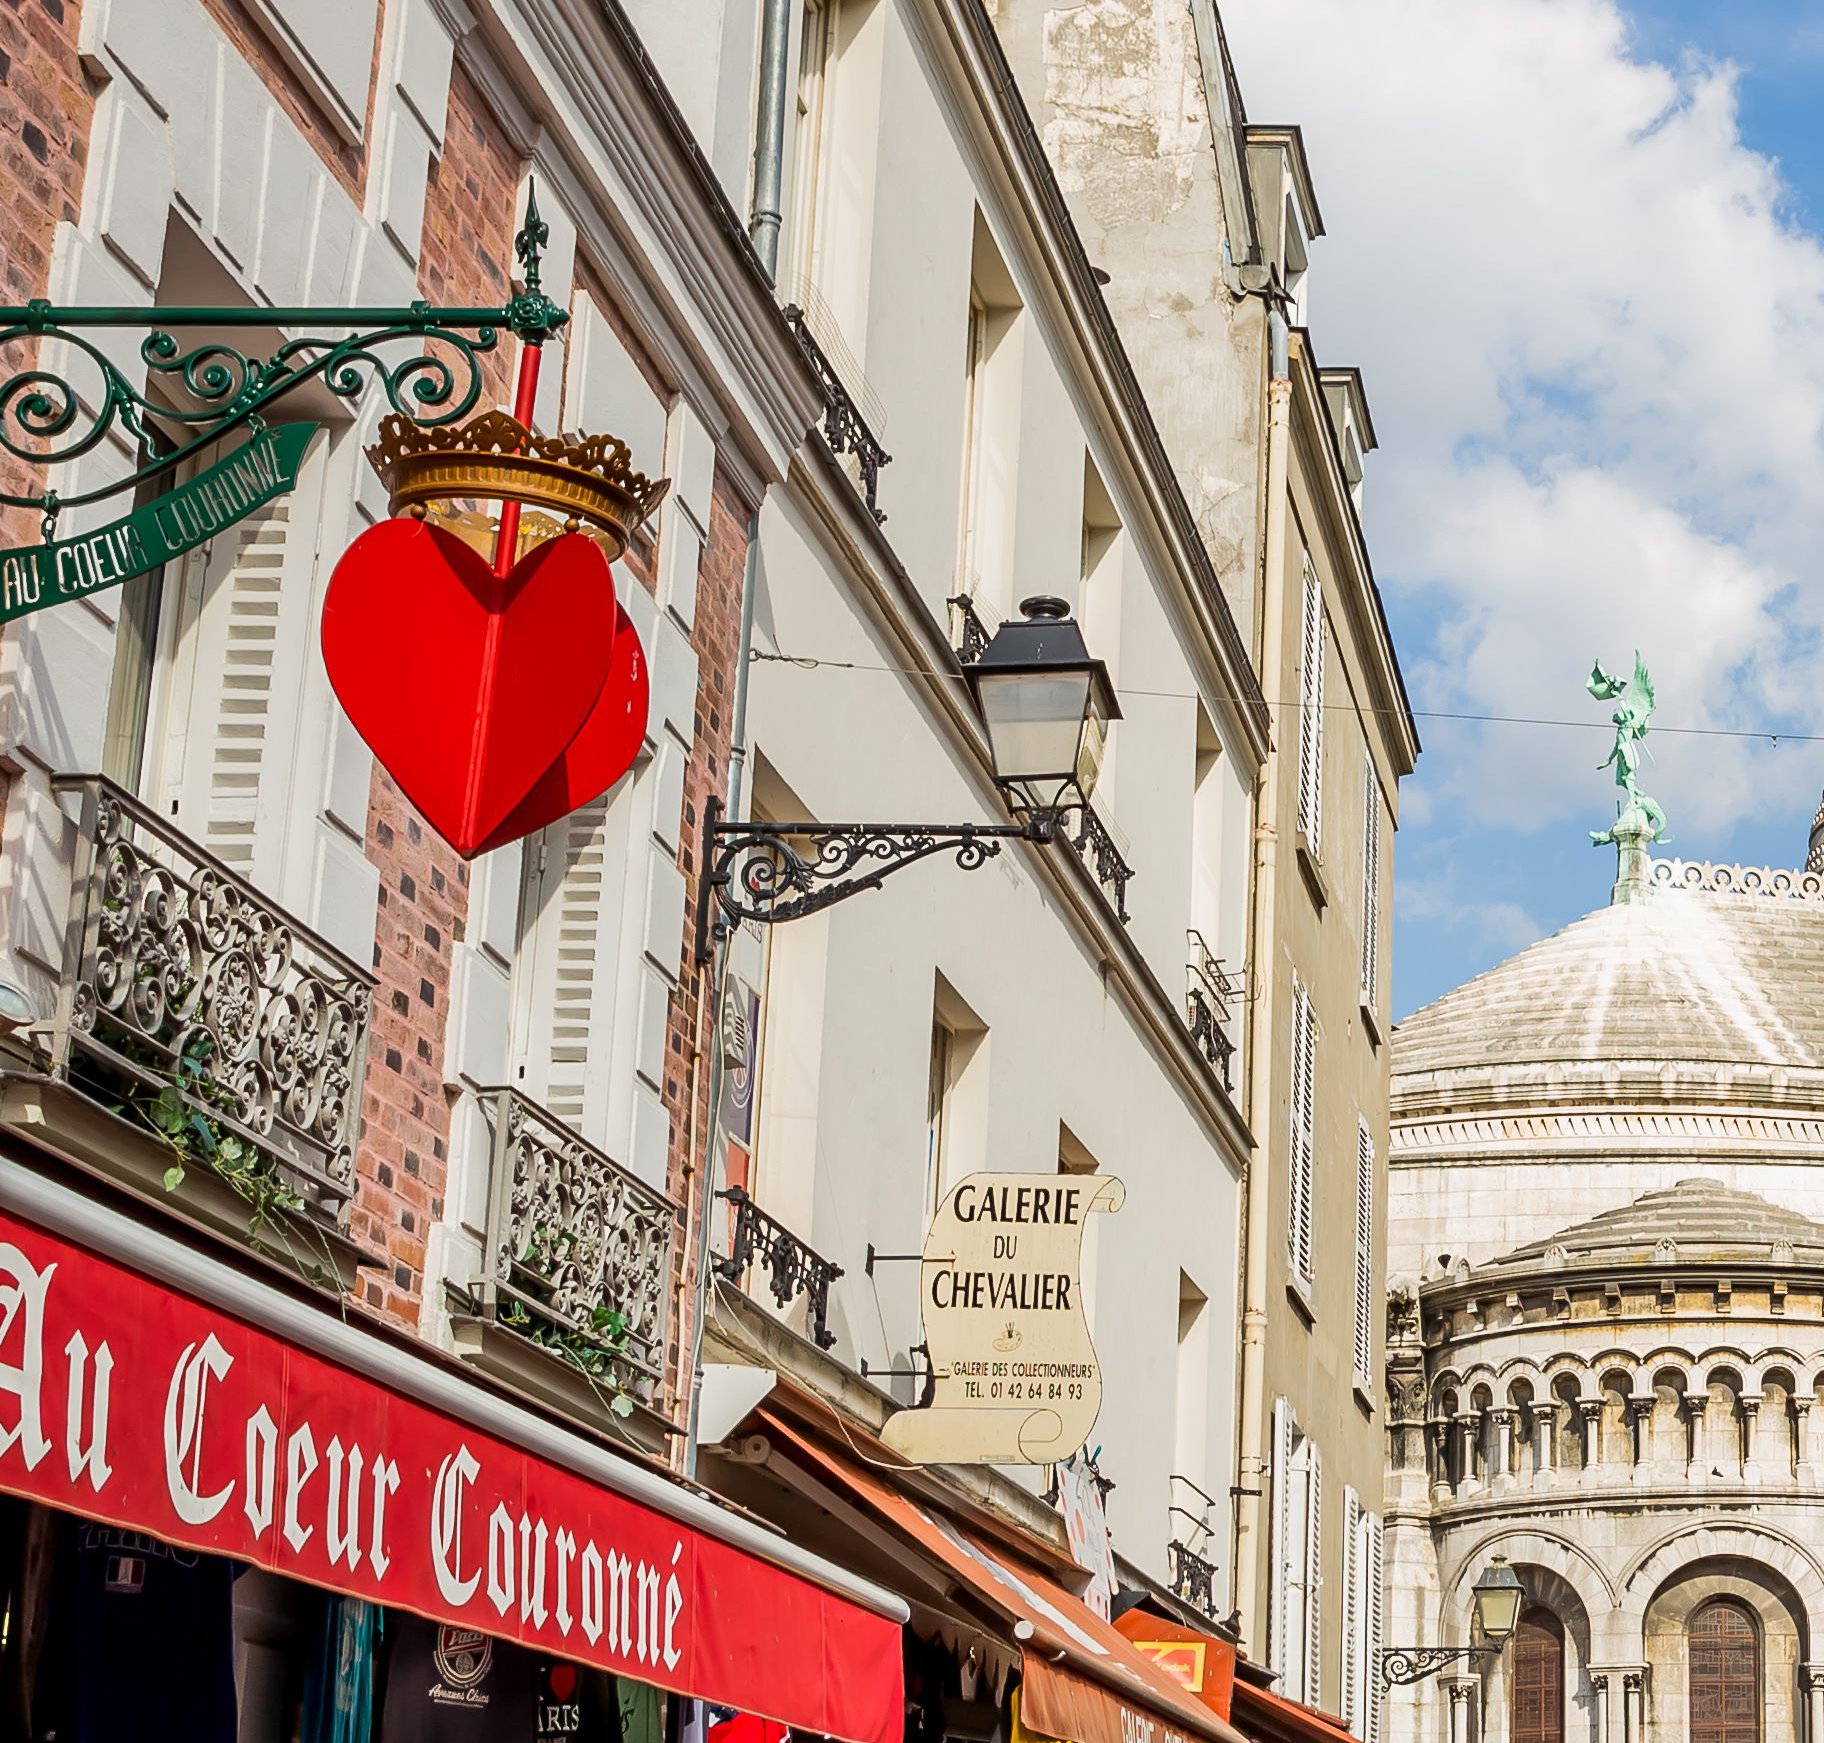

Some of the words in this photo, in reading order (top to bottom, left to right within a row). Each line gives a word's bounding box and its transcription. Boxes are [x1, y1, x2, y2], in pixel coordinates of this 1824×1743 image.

[3, 554, 40, 610] AU
[55, 524, 148, 595] COEUR
[952, 1183, 1081, 1226] GALERIE
[993, 1234, 1018, 1260] DU
[931, 1269, 1072, 1310] CHEVALIER
[991, 1361, 1009, 1377] DES
[965, 1381, 985, 1398] TEL.
[990, 1381, 1003, 1399] 01
[1007, 1382, 1022, 1399] 42
[1028, 1382, 1043, 1399] 64
[1048, 1383, 1062, 1399] 84
[1068, 1383, 1083, 1400] 93
[0, 1241, 113, 1494] Au
[163, 1330, 402, 1584] Coeur
[430, 1444, 686, 1673] Couronné
